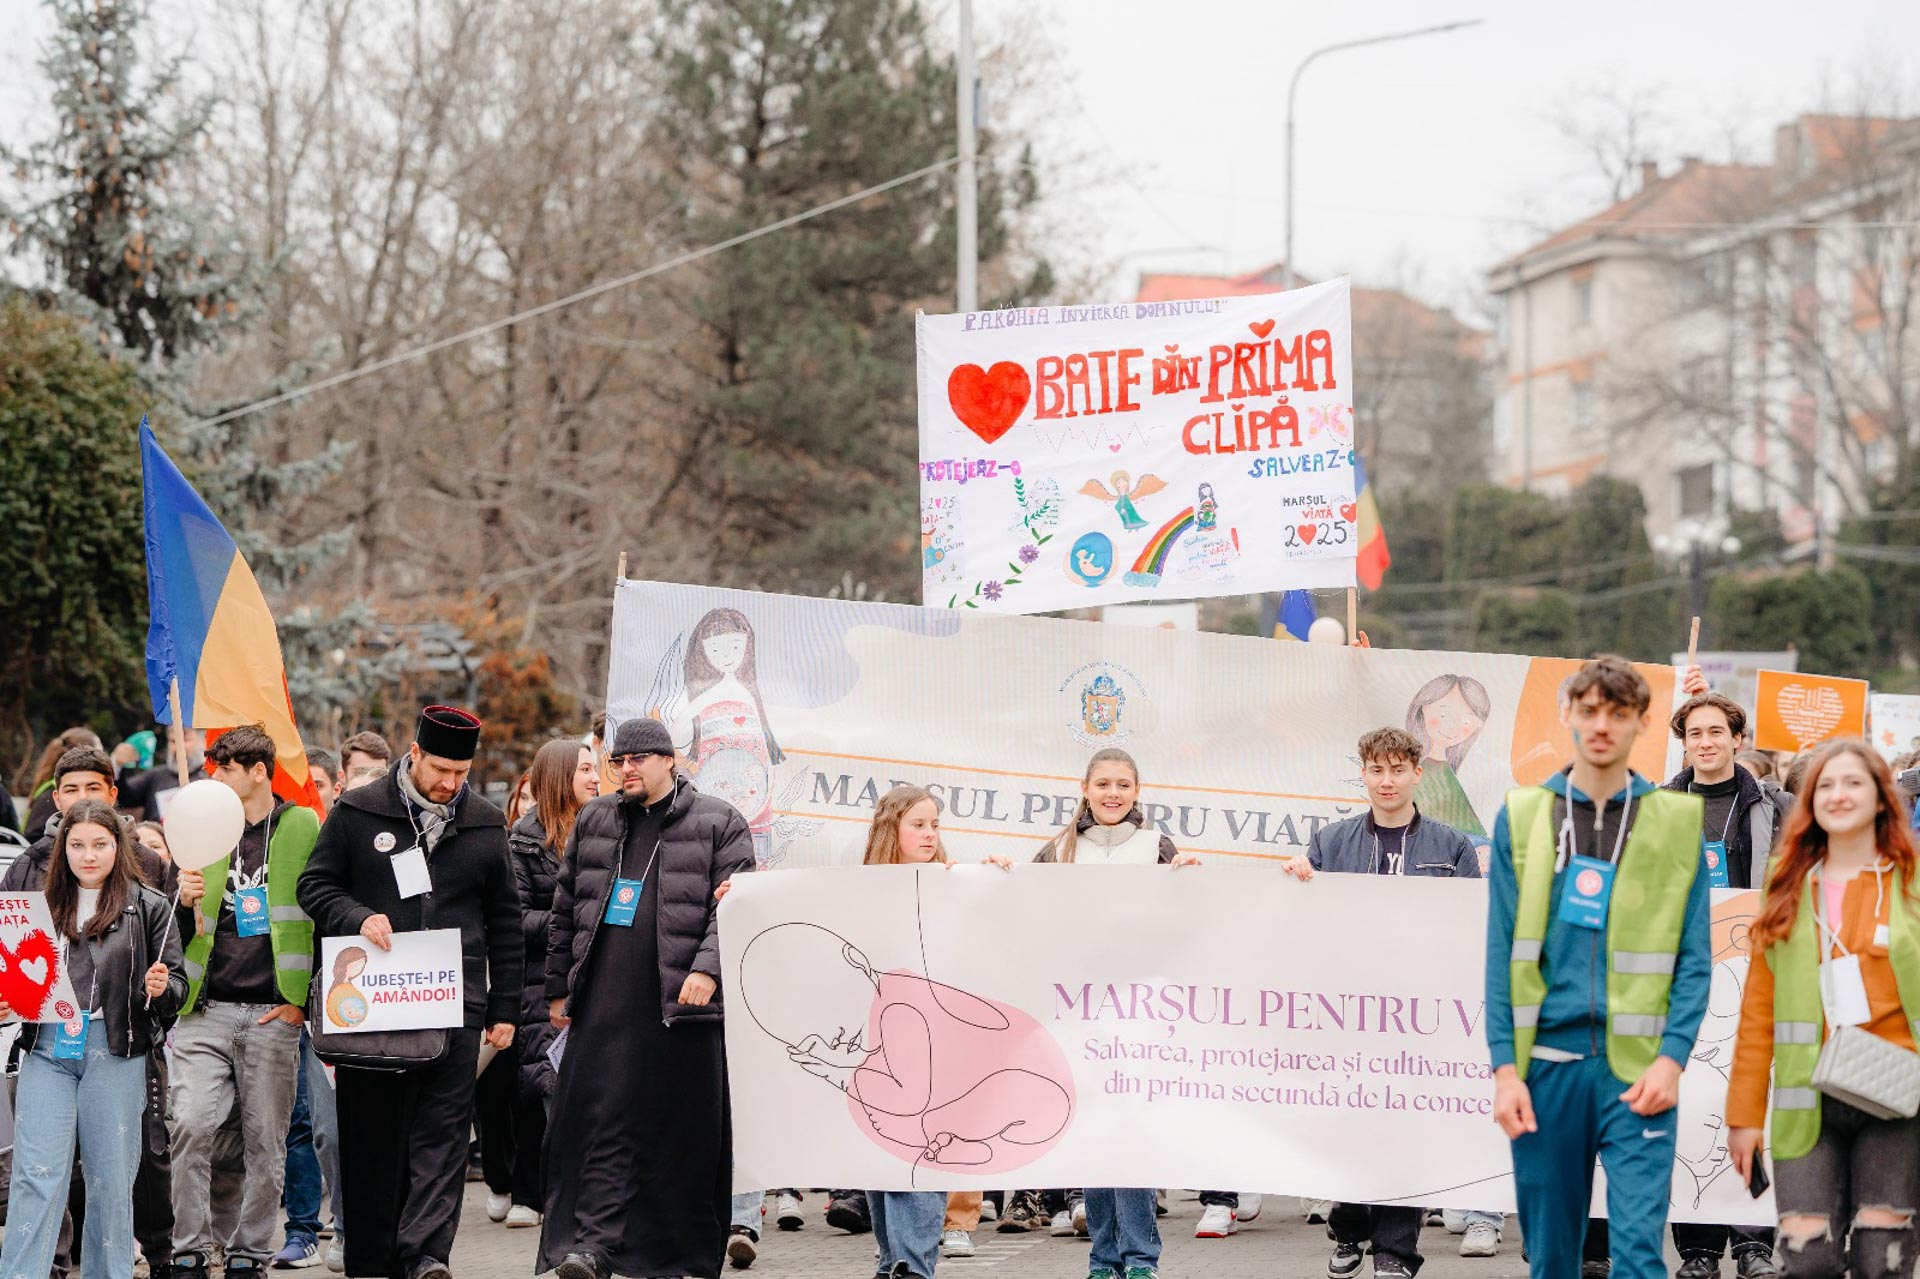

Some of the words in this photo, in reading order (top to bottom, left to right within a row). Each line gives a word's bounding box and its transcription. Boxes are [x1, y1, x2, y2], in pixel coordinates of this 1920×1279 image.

[1034, 348, 1144, 420] BATE
[1200, 319, 1337, 403] PRIMA
[1018, 792, 1211, 838] PERU
[0, 899, 31, 912] EȘTE
[361, 971, 433, 988] IUBEȘTE-I
[438, 970, 456, 983] PE
[372, 987, 456, 1004] AMÂNDOI!
[1053, 983, 1246, 1038] MARȘUL
[1259, 989, 1441, 1036] PENTRU
[1452, 998, 1486, 1038] V
[1084, 1035, 1194, 1066] Salvarea,
[1201, 1047, 1335, 1076] protejarea
[1342, 1051, 1362, 1081] și
[1368, 1050, 1493, 1080] cultivarea
[1104, 1069, 1140, 1094] din
[1148, 1076, 1225, 1102] prima
[1231, 1081, 1340, 1108] secundă
[1347, 1082, 1378, 1108] de
[1384, 1084, 1407, 1111] la
[1413, 1094, 1497, 1124] conce
